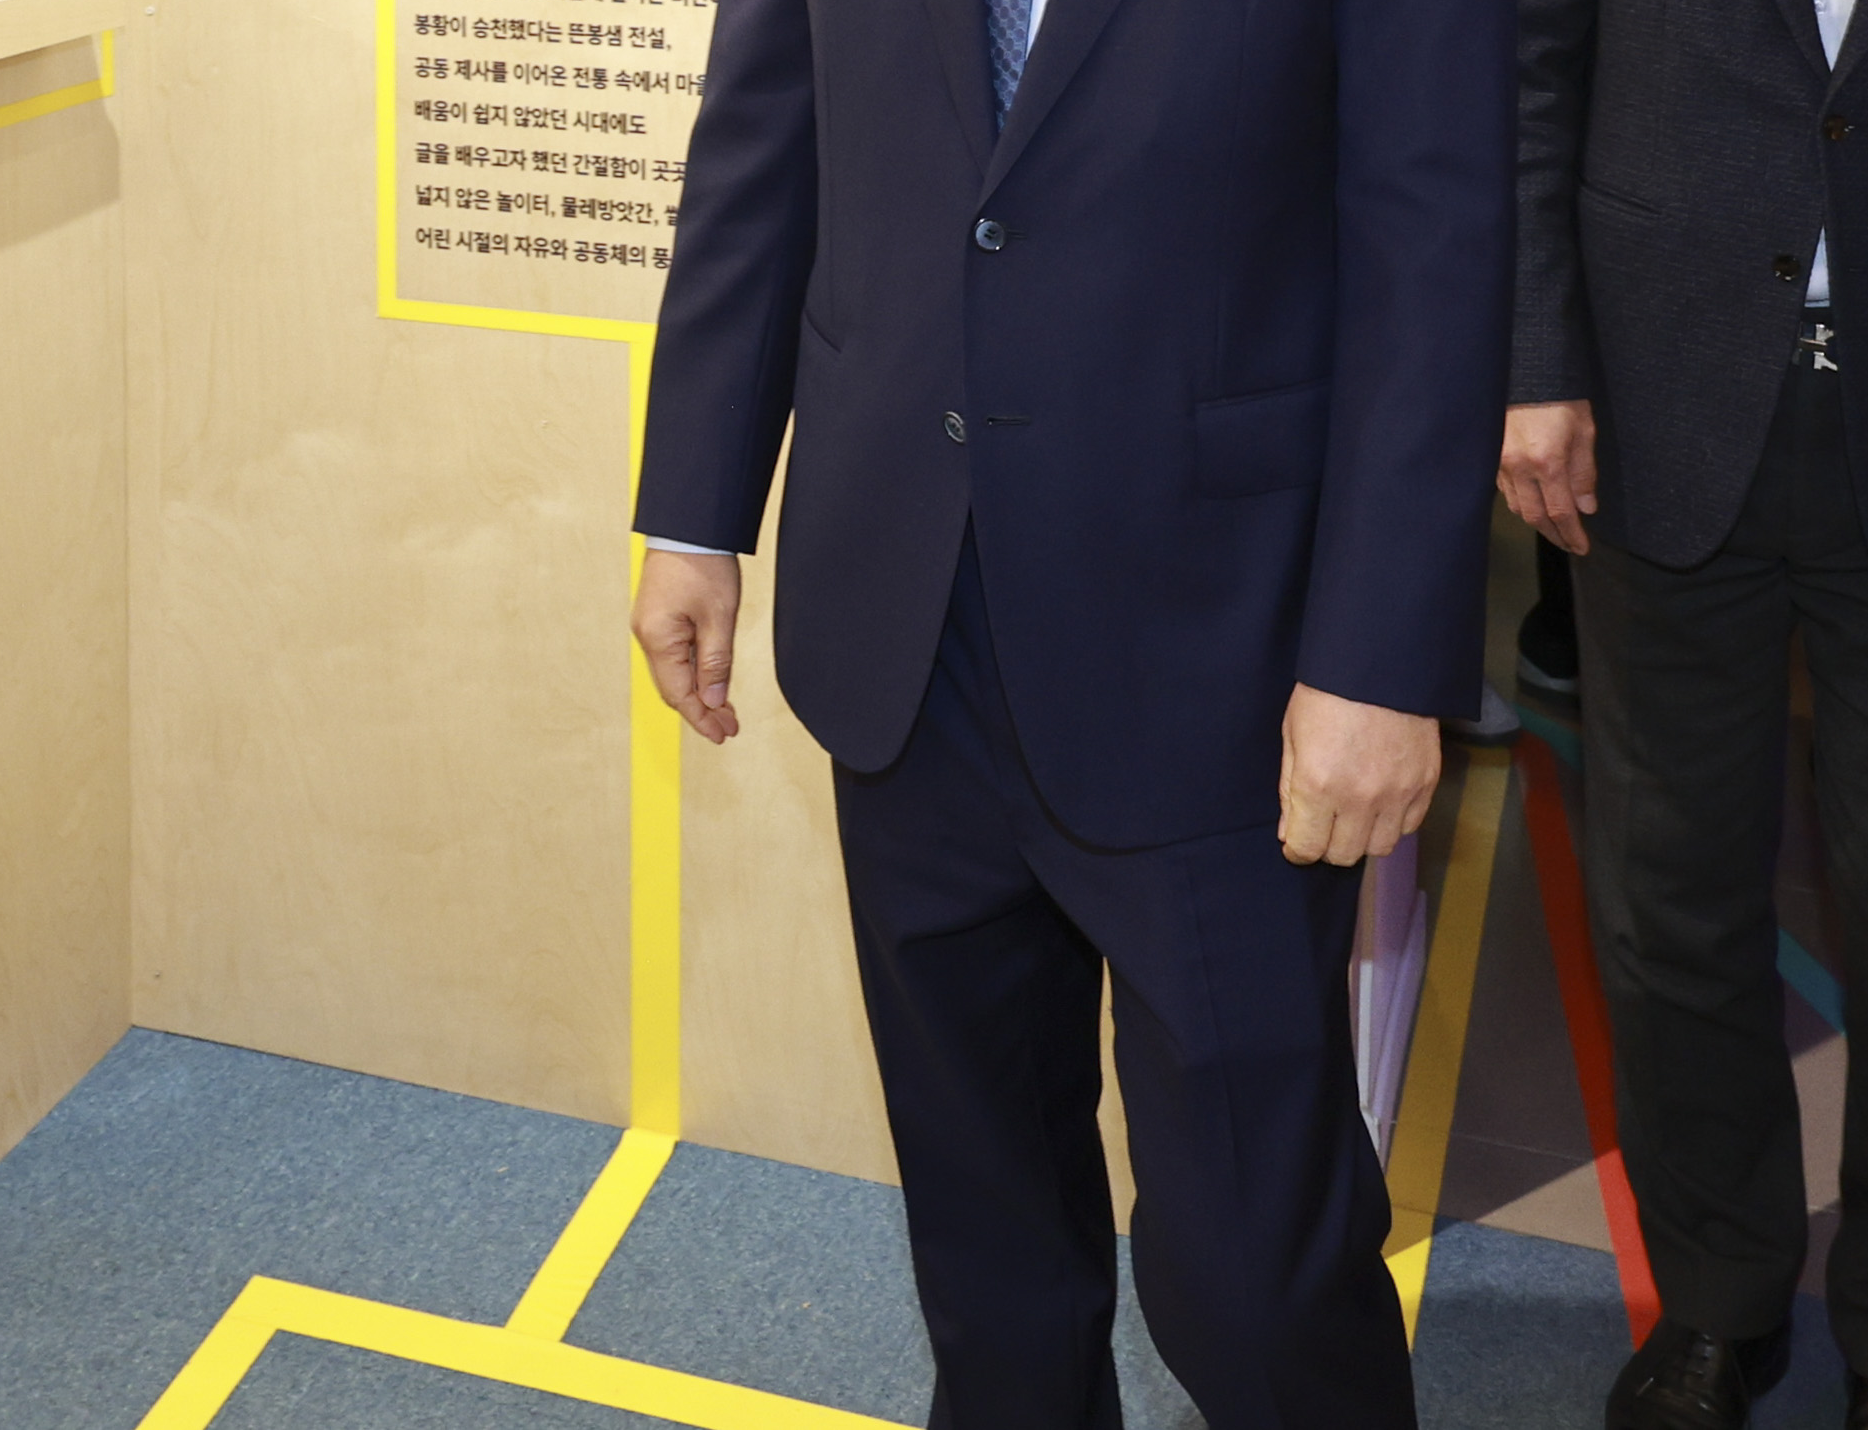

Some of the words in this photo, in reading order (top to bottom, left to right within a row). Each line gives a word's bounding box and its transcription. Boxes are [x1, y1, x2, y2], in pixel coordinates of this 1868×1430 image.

[414, 14, 466, 37] 봉황이
[473, 18, 562, 42] 승천했다는
[568, 22, 622, 47] 뜬봉샘
[628, 27, 672, 51] 전설,
[414, 57, 448, 79] 공동
[454, 59, 507, 83] 제사를
[514, 63, 567, 87] 이어온
[573, 68, 608, 89] 전통
[615, 70, 669, 93] 속에서
[415, 100, 467, 123] 배움이
[473, 103, 508, 126] 쉽지
[513, 106, 567, 130] 않았던
[573, 110, 647, 135] 시대에도
[415, 142, 449, 165] 글을
[455, 145, 526, 171] 배우고자
[532, 151, 567, 173] 했던
[573, 154, 646, 180] 간절함이
[416, 184, 449, 207] 넓지
[455, 188, 491, 210] 않은
[496, 191, 556, 217] 놀이터,
[561, 196, 659, 226] 물레방앗간,
[416, 228, 450, 249] 어린
[456, 231, 509, 254] 시절의
[514, 236, 567, 260] 자유와
[573, 240, 646, 267] 공동체의
